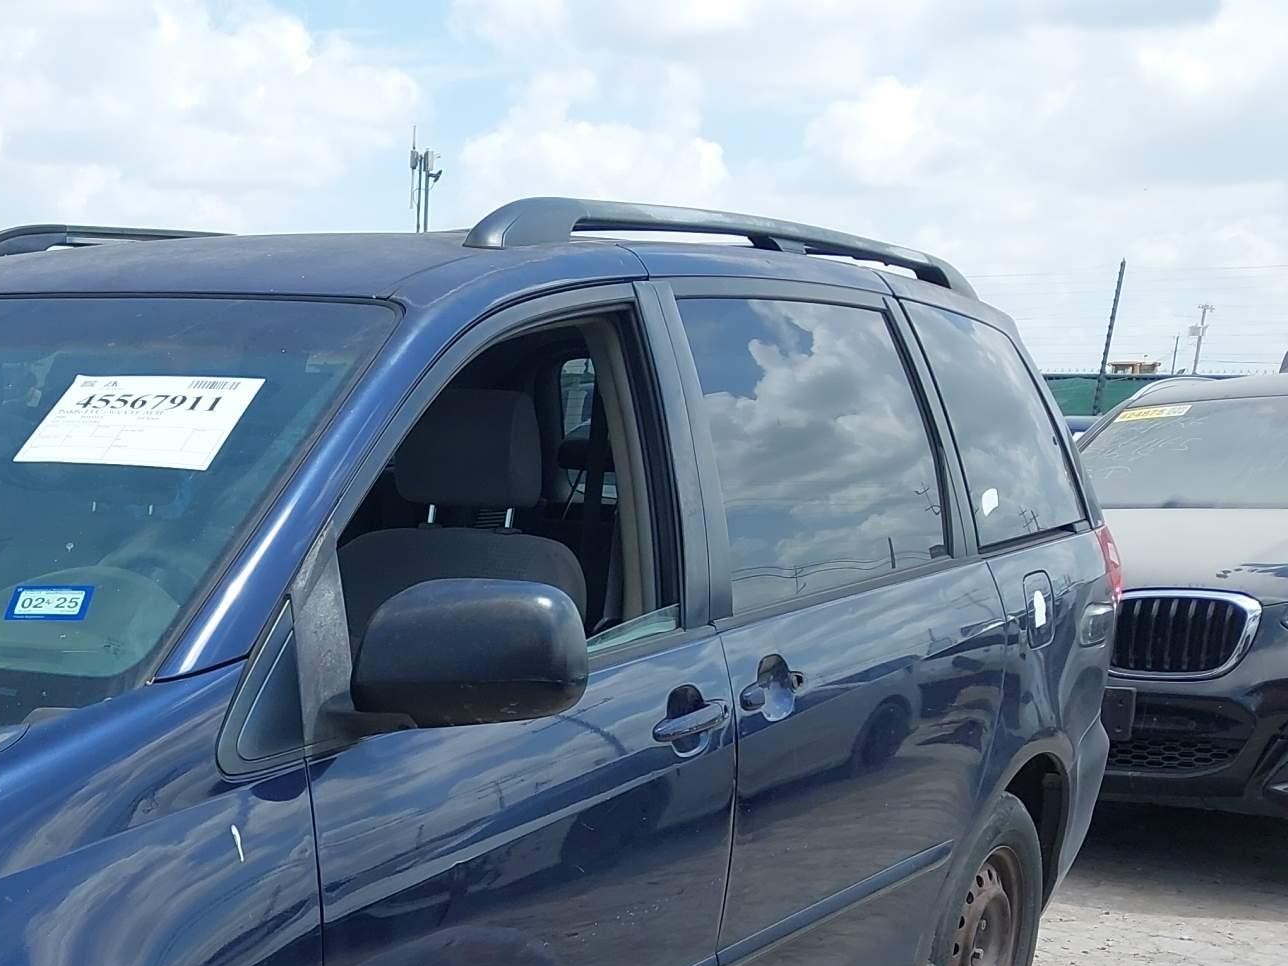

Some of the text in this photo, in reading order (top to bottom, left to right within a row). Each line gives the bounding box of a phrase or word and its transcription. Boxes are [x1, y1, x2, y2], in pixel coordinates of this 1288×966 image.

[75, 393, 223, 412] 45567911
[20, 597, 81, 609] 02 25
